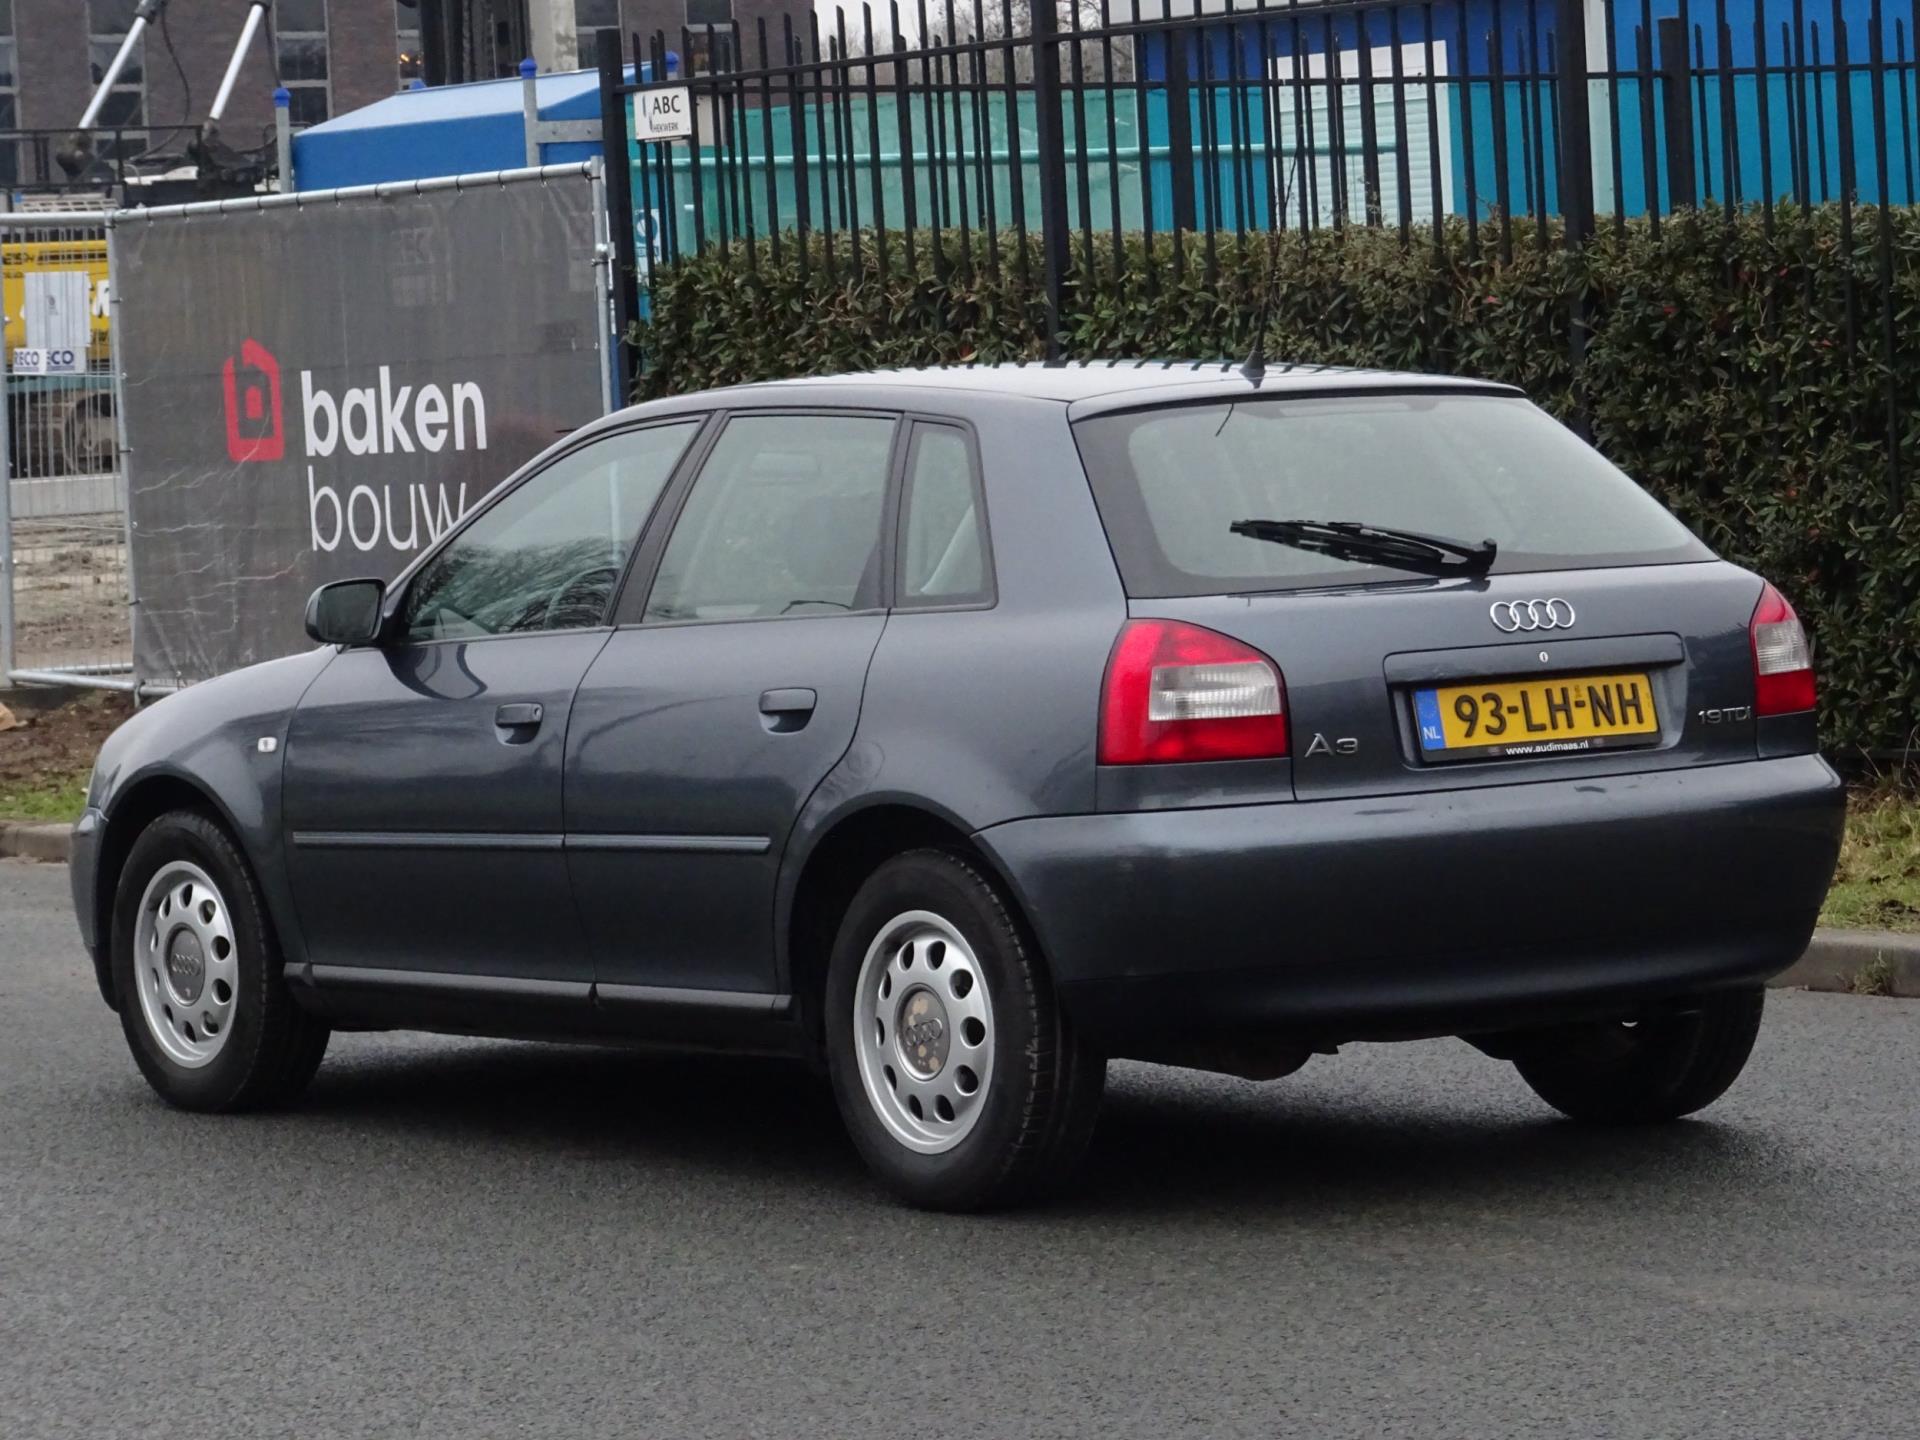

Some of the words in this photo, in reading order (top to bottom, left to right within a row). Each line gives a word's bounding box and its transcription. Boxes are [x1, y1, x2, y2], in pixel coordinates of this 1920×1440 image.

[652, 94, 681, 115] ABC
[301, 365, 487, 457] baken
[307, 465, 466, 551] bouw
[1454, 682, 1644, 738] 93-LH-NH
[1304, 732, 1358, 758] A3
[1423, 727, 1440, 740] NL
[1506, 740, 1589, 756] www.audimaas.nl
